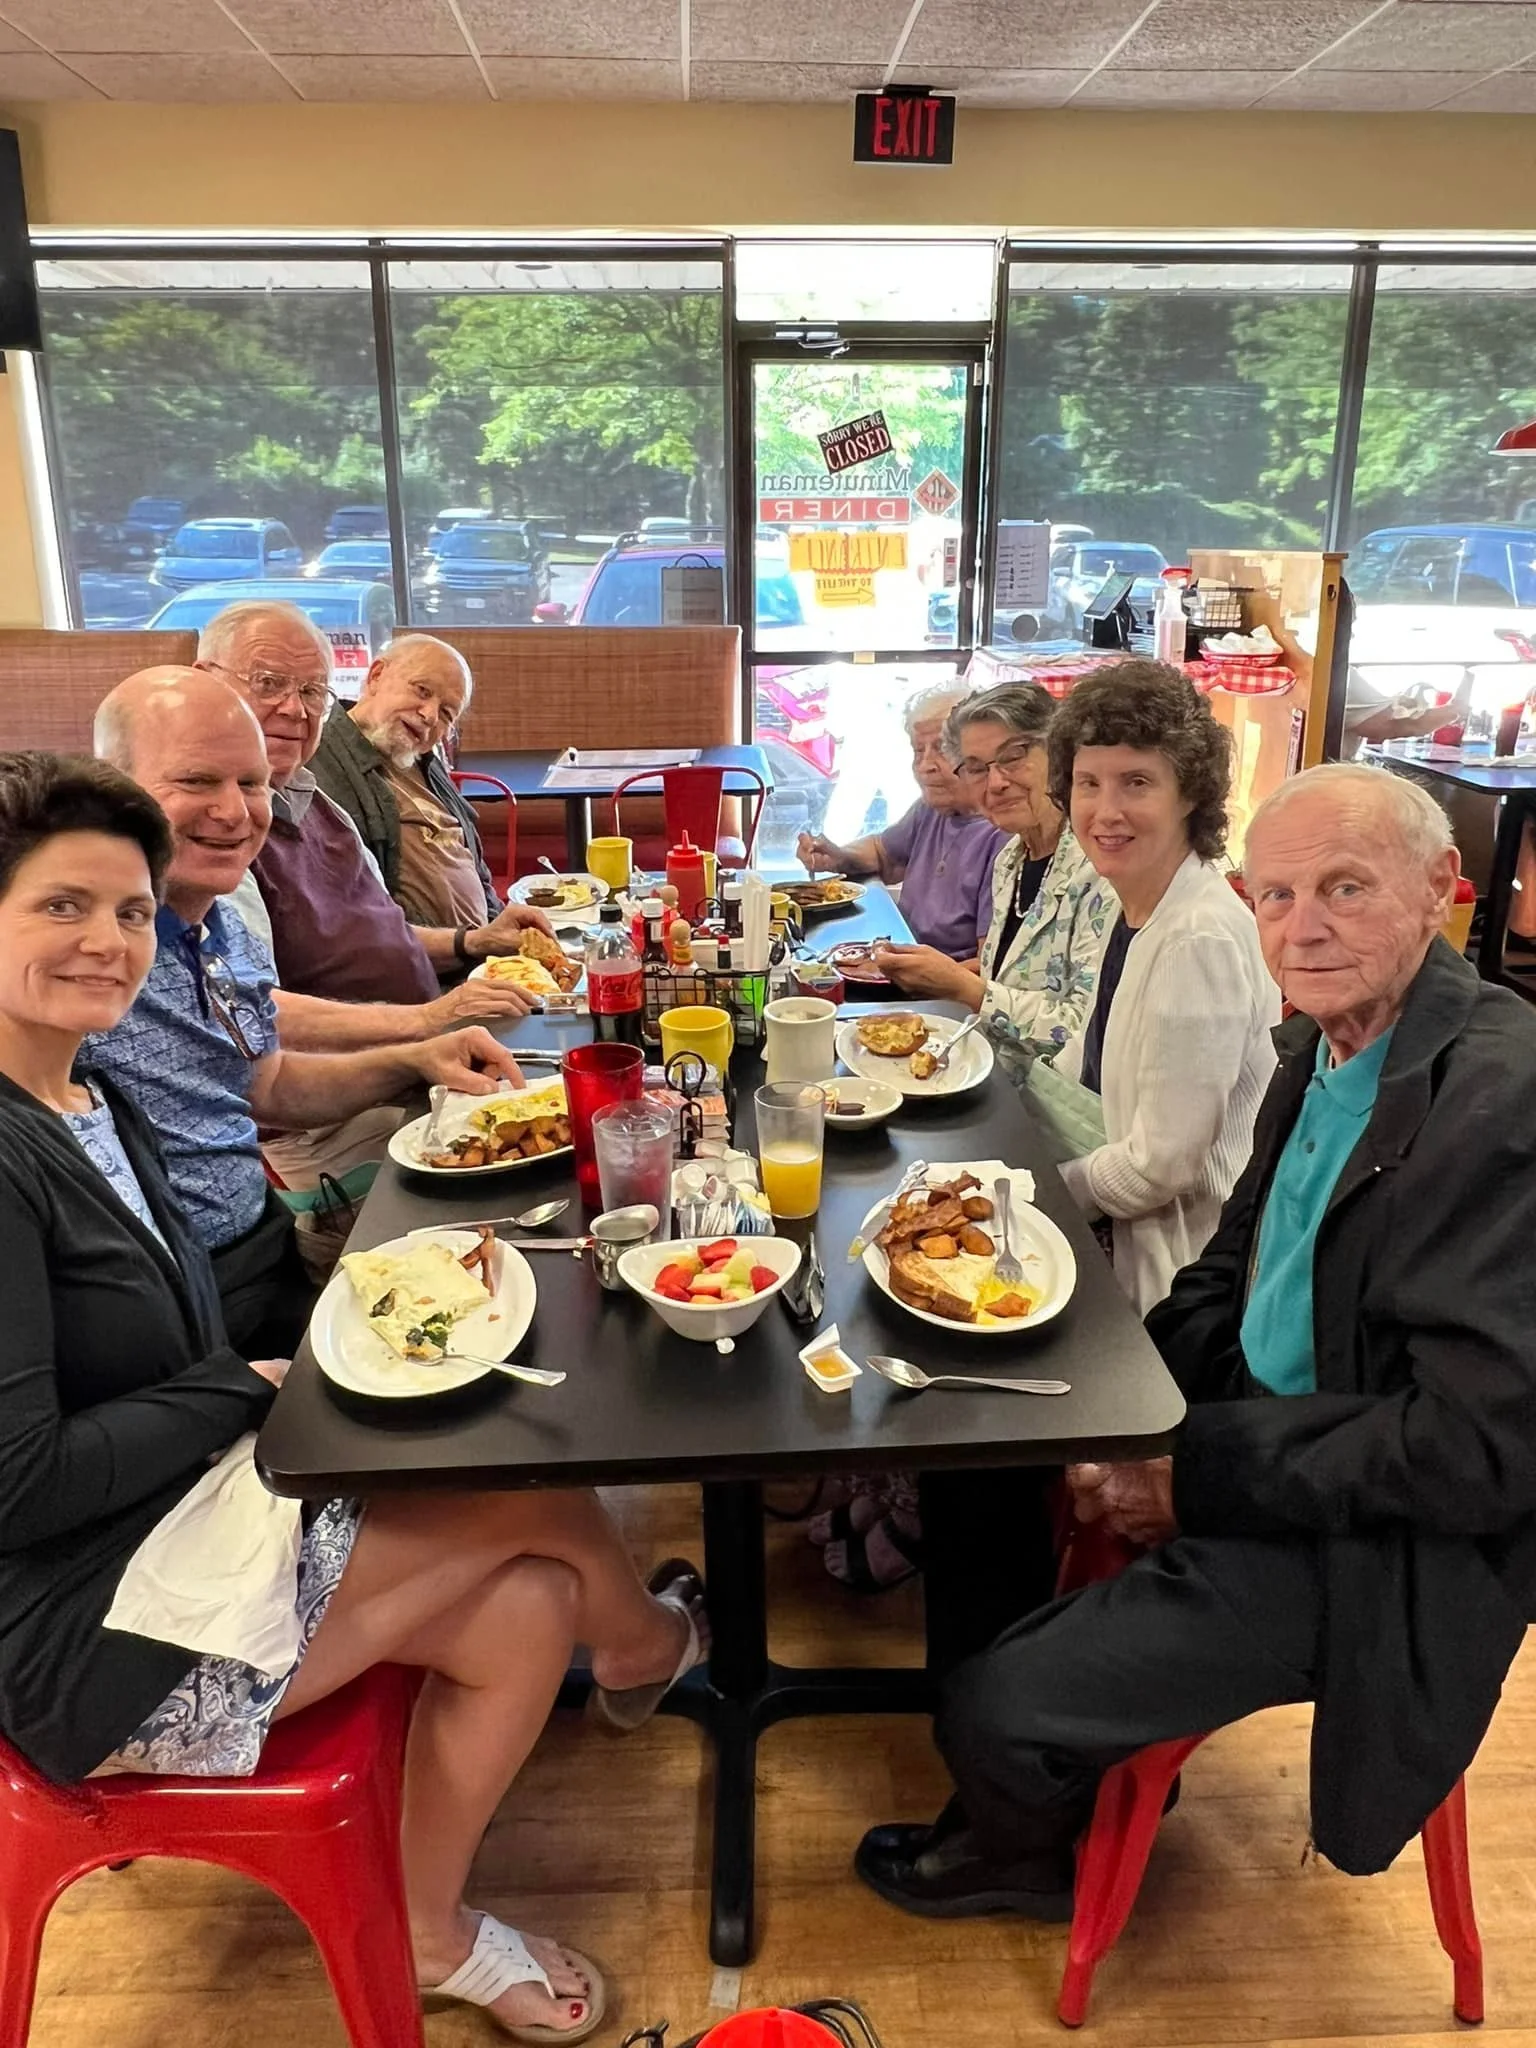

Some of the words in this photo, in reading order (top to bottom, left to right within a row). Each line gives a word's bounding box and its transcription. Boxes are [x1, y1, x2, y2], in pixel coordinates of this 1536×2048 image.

[873, 97, 941, 157] EXIT
[820, 425, 852, 447] SORRY
[852, 412, 884, 433] WE'RE
[825, 427, 890, 470] CLOSED
[326, 632, 367, 645] man
